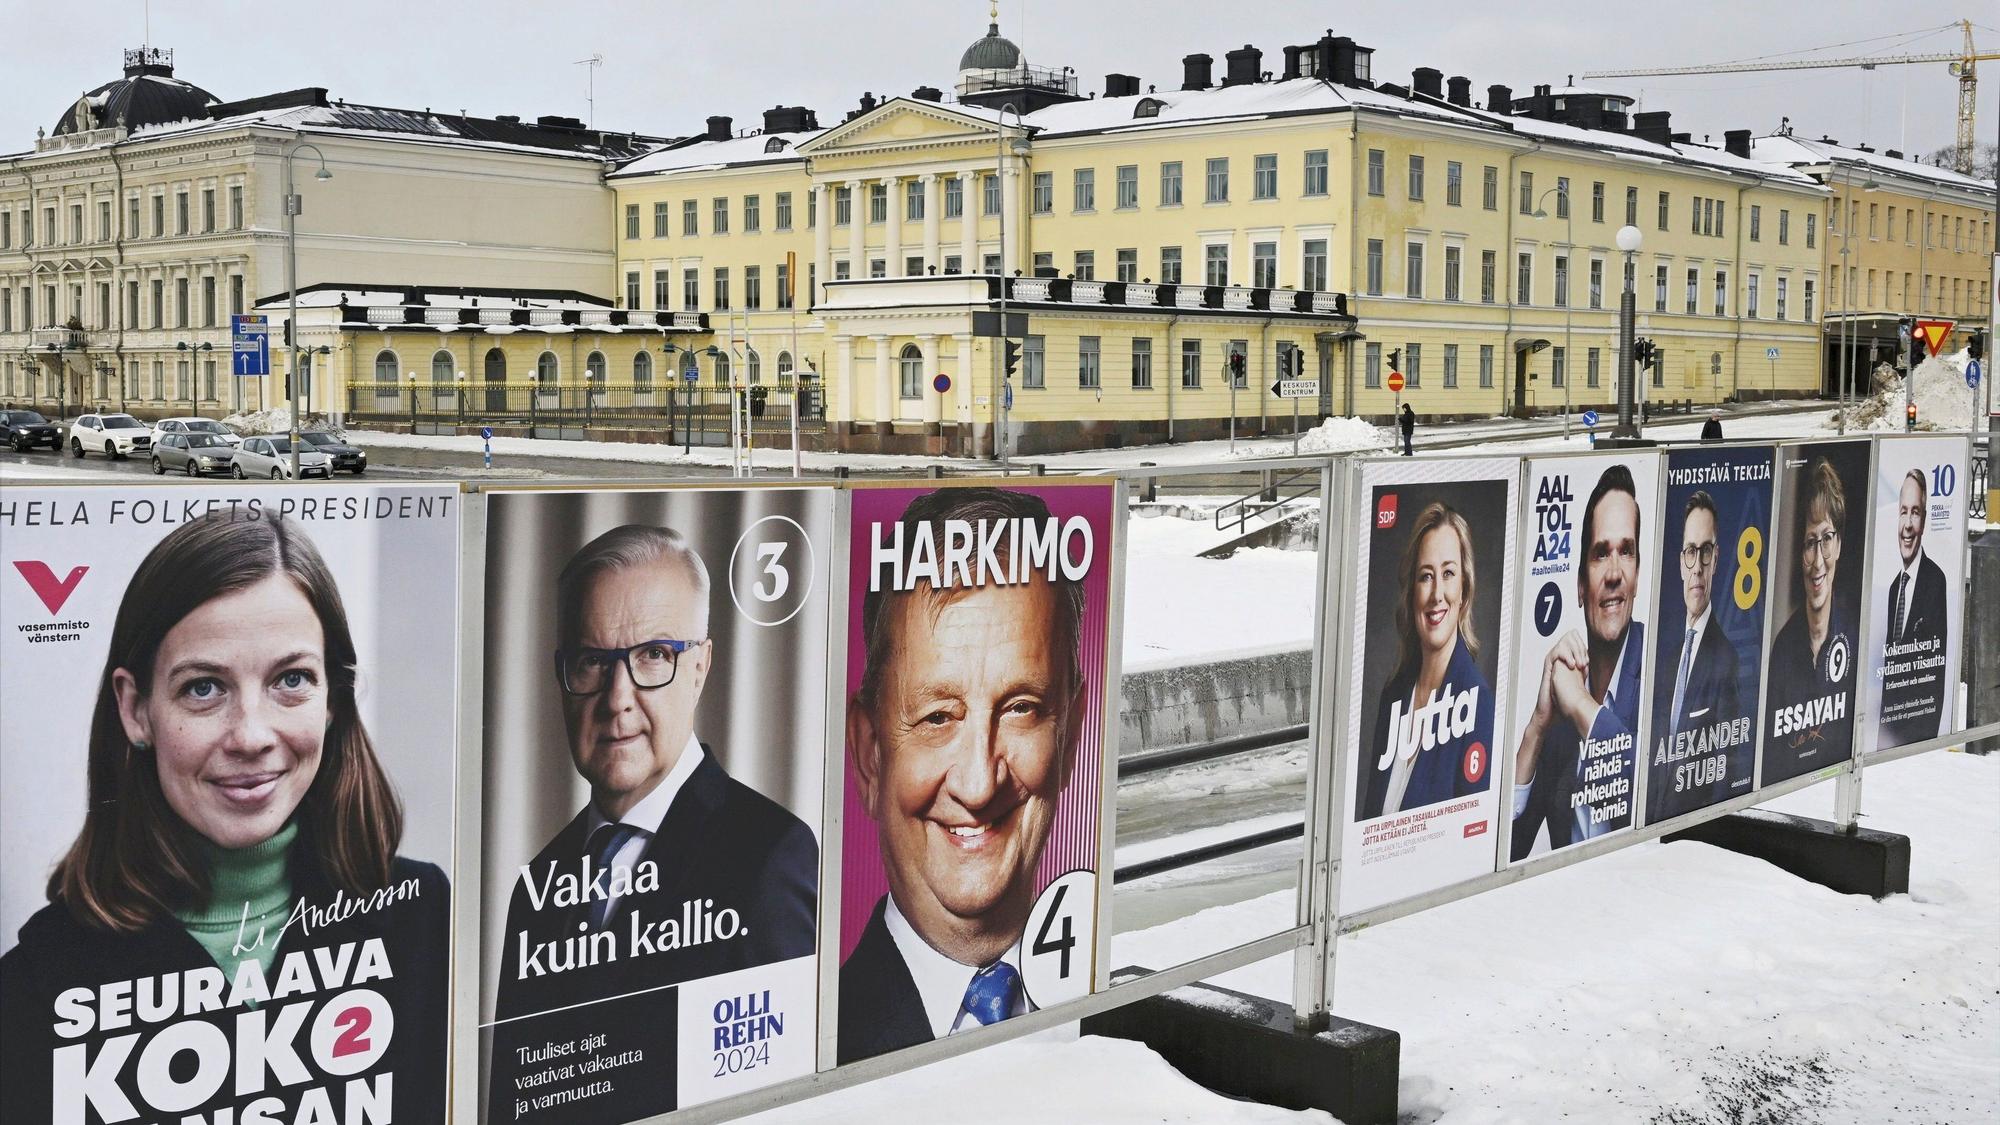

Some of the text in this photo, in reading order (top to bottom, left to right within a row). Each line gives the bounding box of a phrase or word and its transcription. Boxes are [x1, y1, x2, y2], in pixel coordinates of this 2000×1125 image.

[1669, 463, 1730, 485] YHDISTÄVÄ
[1734, 460, 1770, 481] TEKIJÄ
[1931, 464, 1955, 497] 10
[1536, 475, 1573, 504] AAL
[0, 496, 453, 525] HELA FOLKETS PRESIDENT
[1379, 511, 1395, 523] SDP
[1536, 504, 1572, 533] TOL
[870, 515, 1093, 592] HARKIMO
[1533, 532, 1570, 562] A24
[752, 542, 789, 602] 3
[1734, 526, 1762, 610] 8
[1544, 595, 1555, 623] 7
[18, 620, 90, 632] vasemmisto
[27, 631, 80, 643] vänstern
[1834, 648, 1843, 676] 9
[1882, 635, 1940, 657] Kokemuksen ja
[1876, 654, 1945, 680] sydämen viisautta
[1378, 682, 1479, 771] Jutta
[1774, 692, 1847, 738] ESSAYAH
[1579, 733, 1632, 760] Viisautta
[1654, 717, 1750, 766] ALEXANDER
[1470, 750, 1478, 774] 6
[1585, 755, 1621, 782] nähdä
[1675, 754, 1727, 792] STUBB
[1571, 778, 1629, 808] rohkeutta
[1363, 824, 1380, 835] JUTTA
[1381, 816, 1411, 831] URPILAINEN
[1412, 808, 1444, 822] TASAVALLAN
[1590, 800, 1627, 825] toimia
[1362, 835, 1379, 846] JOTTA
[1381, 828, 1400, 842] KETÄÄN
[1402, 828, 1408, 836] EI
[519, 854, 659, 912] Vakaa
[232, 877, 420, 956] Li Andersson
[1032, 885, 1076, 979] 4
[518, 898, 749, 980] kuin kallio.
[53, 938, 394, 1038] SEURAAVA
[713, 990, 770, 1024] OLLI
[332, 1006, 372, 1058] 2
[713, 1012, 784, 1051] REHN
[516, 1033, 607, 1065] Tuuliset ajat
[713, 1042, 770, 1078] 2024
[515, 1049, 643, 1090] vaativat vakautta
[515, 1080, 614, 1119] ja varmuutta.
